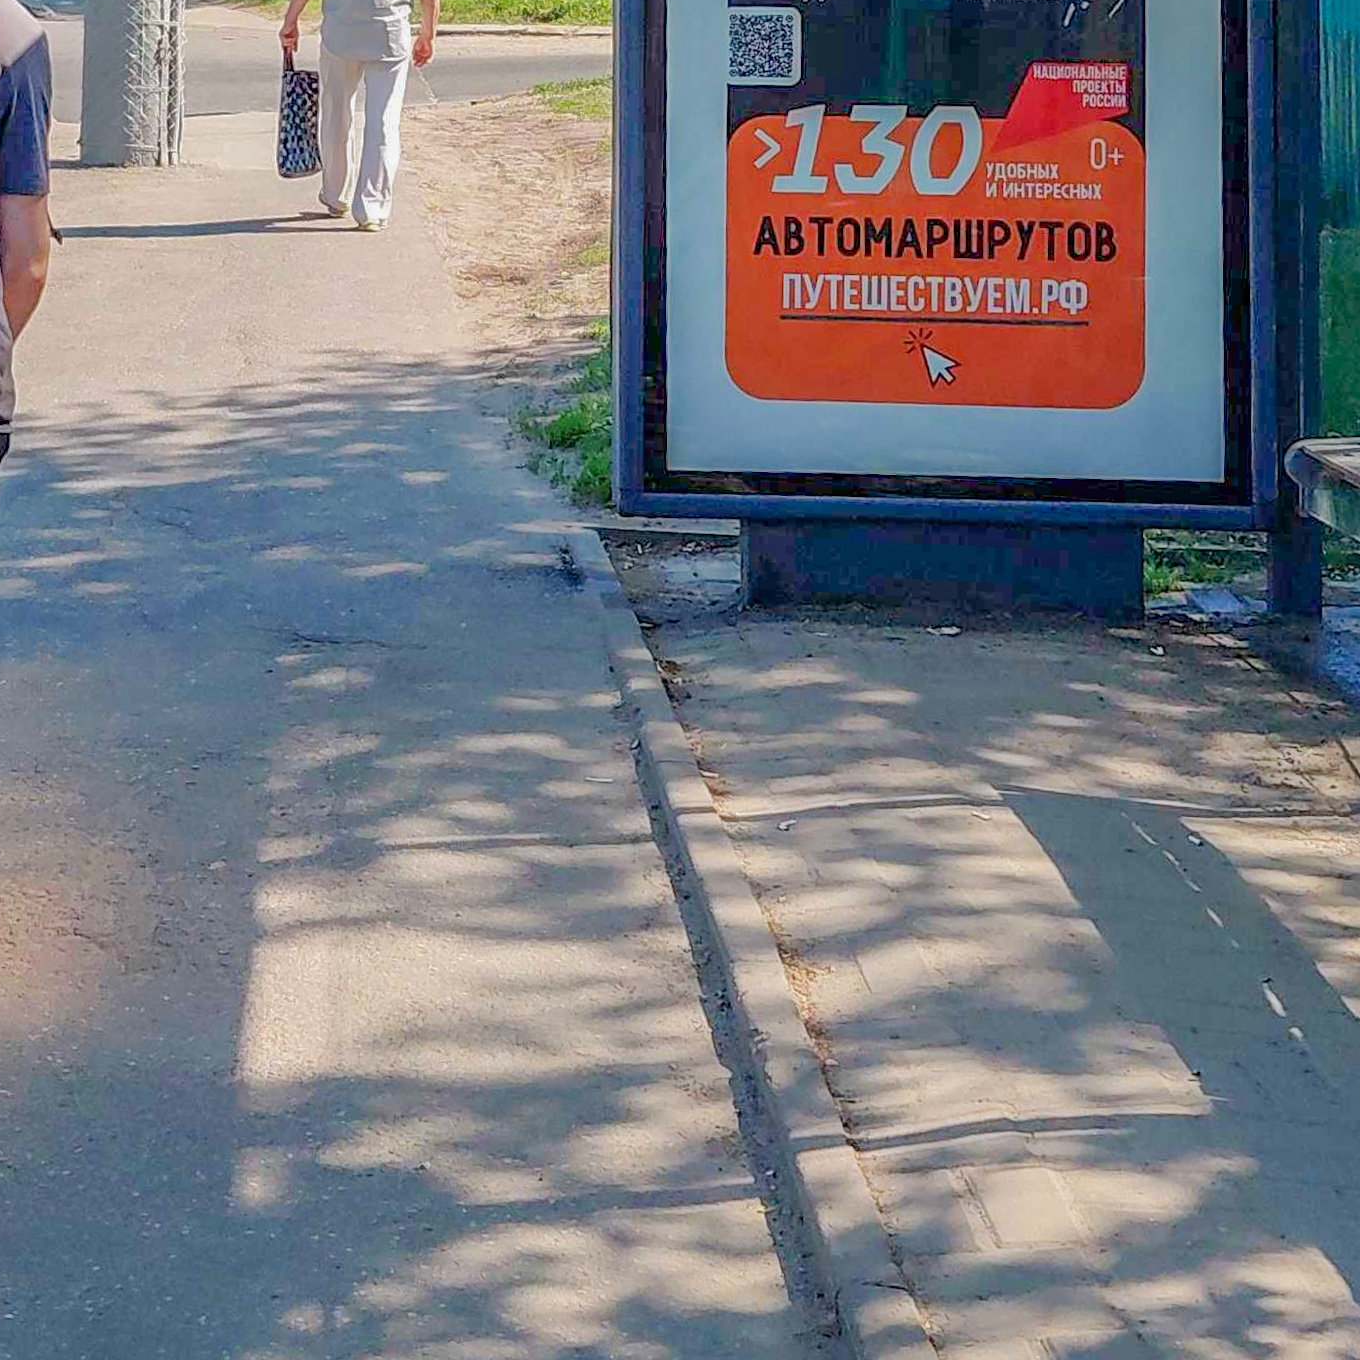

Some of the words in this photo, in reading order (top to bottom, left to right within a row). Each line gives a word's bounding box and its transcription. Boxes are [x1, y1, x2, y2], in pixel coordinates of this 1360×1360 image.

[1033, 65, 1127, 81] НАЦИОНАЛЬНЫЕ
[1072, 79, 1127, 94] ПРОЕКТЫ
[1082, 93, 1127, 108] РОССИИ
[1090, 138, 1124, 170] 0+
[985, 162, 1060, 182] УДОБНЫХ
[985, 183, 998, 198] И
[1003, 182, 1103, 200] ИНТЕРЕСНЫХ
[752, 216, 1117, 262] АВТОМАРШРУТОВ
[782, 273, 1089, 316] ПУТЕШЕСТВУЕМ.РФ
